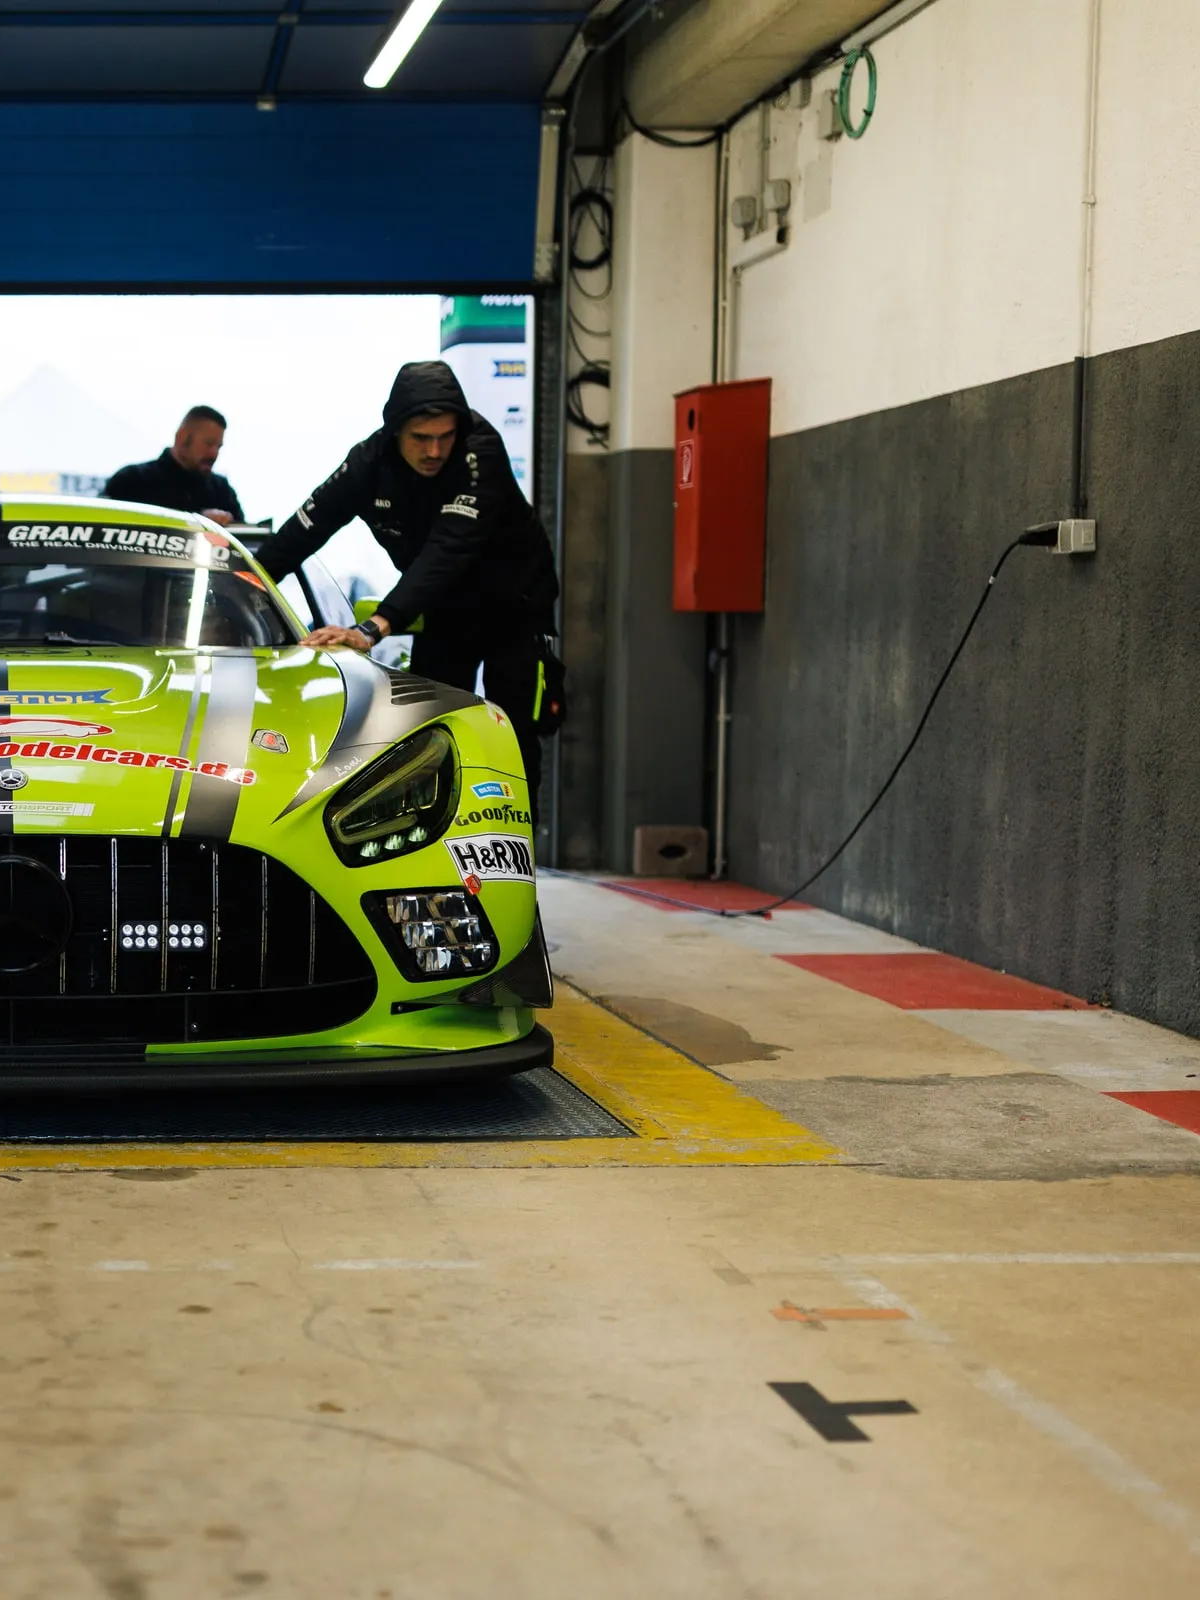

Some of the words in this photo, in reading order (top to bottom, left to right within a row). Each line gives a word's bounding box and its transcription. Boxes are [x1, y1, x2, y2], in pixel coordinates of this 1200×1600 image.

[374, 498, 391, 508] AKO
[7, 525, 93, 543] GRAN
[43, 541, 81, 549] REAL
[85, 542, 145, 553] DRIVING
[149, 548, 229, 569] SIMULOR
[455, 804, 531, 826] GOODYEA
[452, 840, 515, 874] H&R
